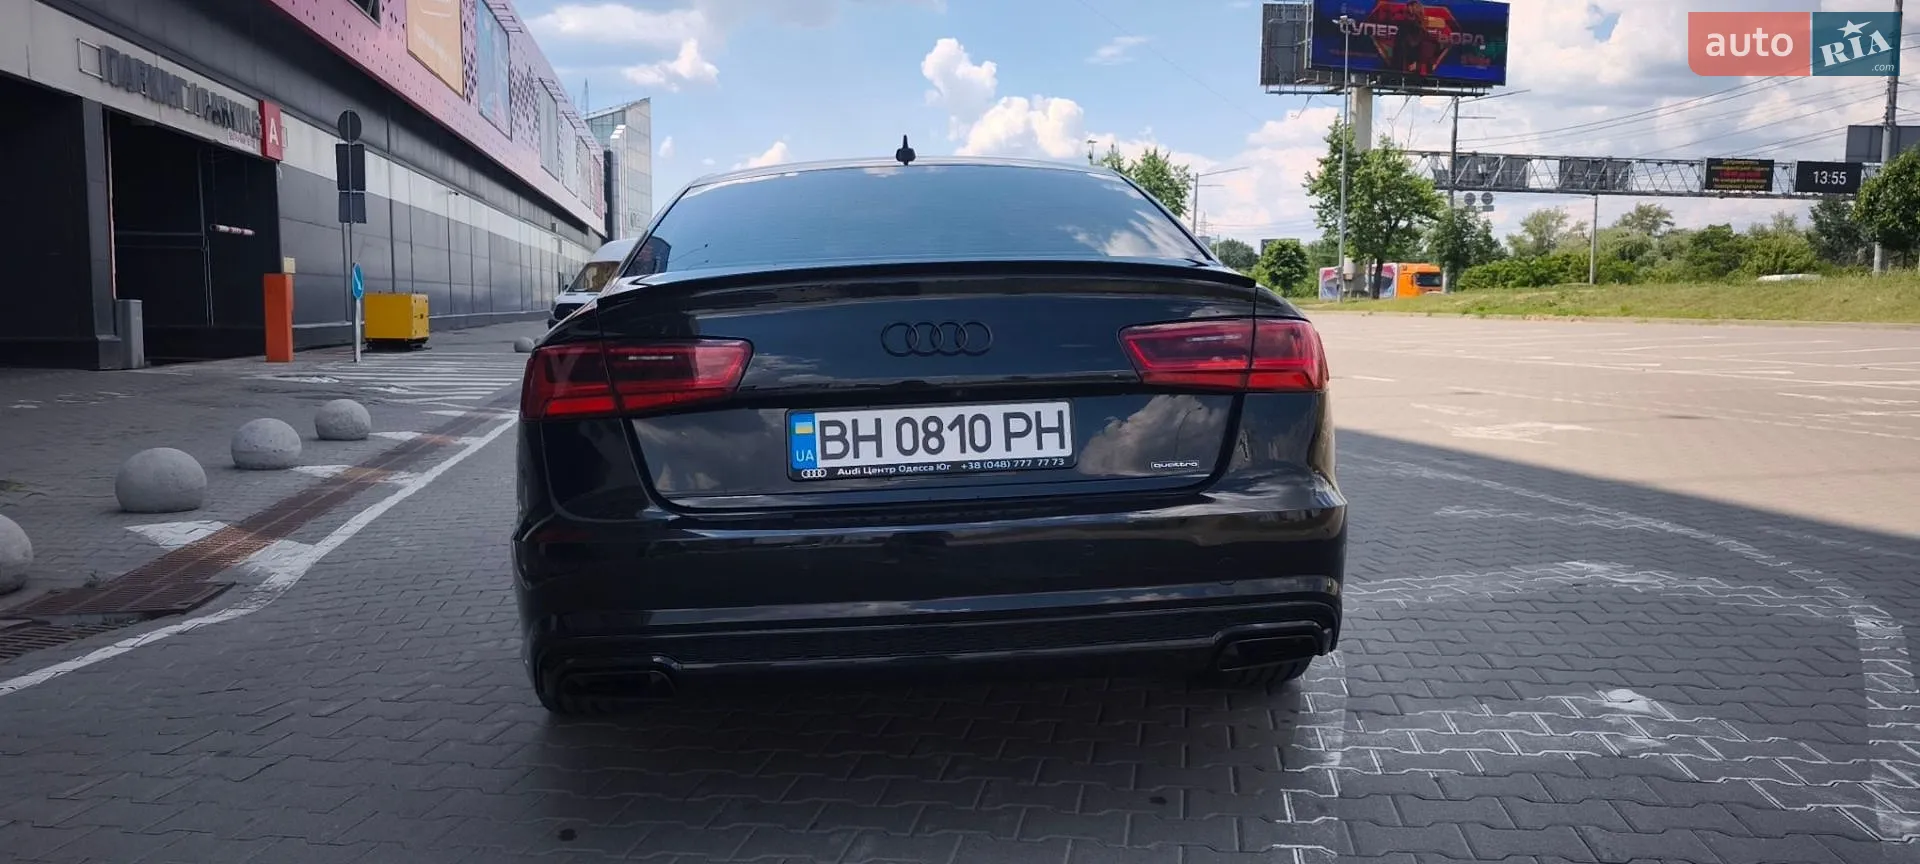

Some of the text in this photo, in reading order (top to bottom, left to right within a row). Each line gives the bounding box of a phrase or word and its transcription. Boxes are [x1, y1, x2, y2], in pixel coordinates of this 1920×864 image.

[1812, 170, 1847, 185] 13:55
[818, 409, 1066, 461] BH 0810 PH
[796, 450, 815, 462] UA
[837, 463, 951, 476] Audi Центр Одесса Юг
[961, 458, 1065, 470] +38 (048) 777 77 73
[1152, 461, 1199, 469] quattro
